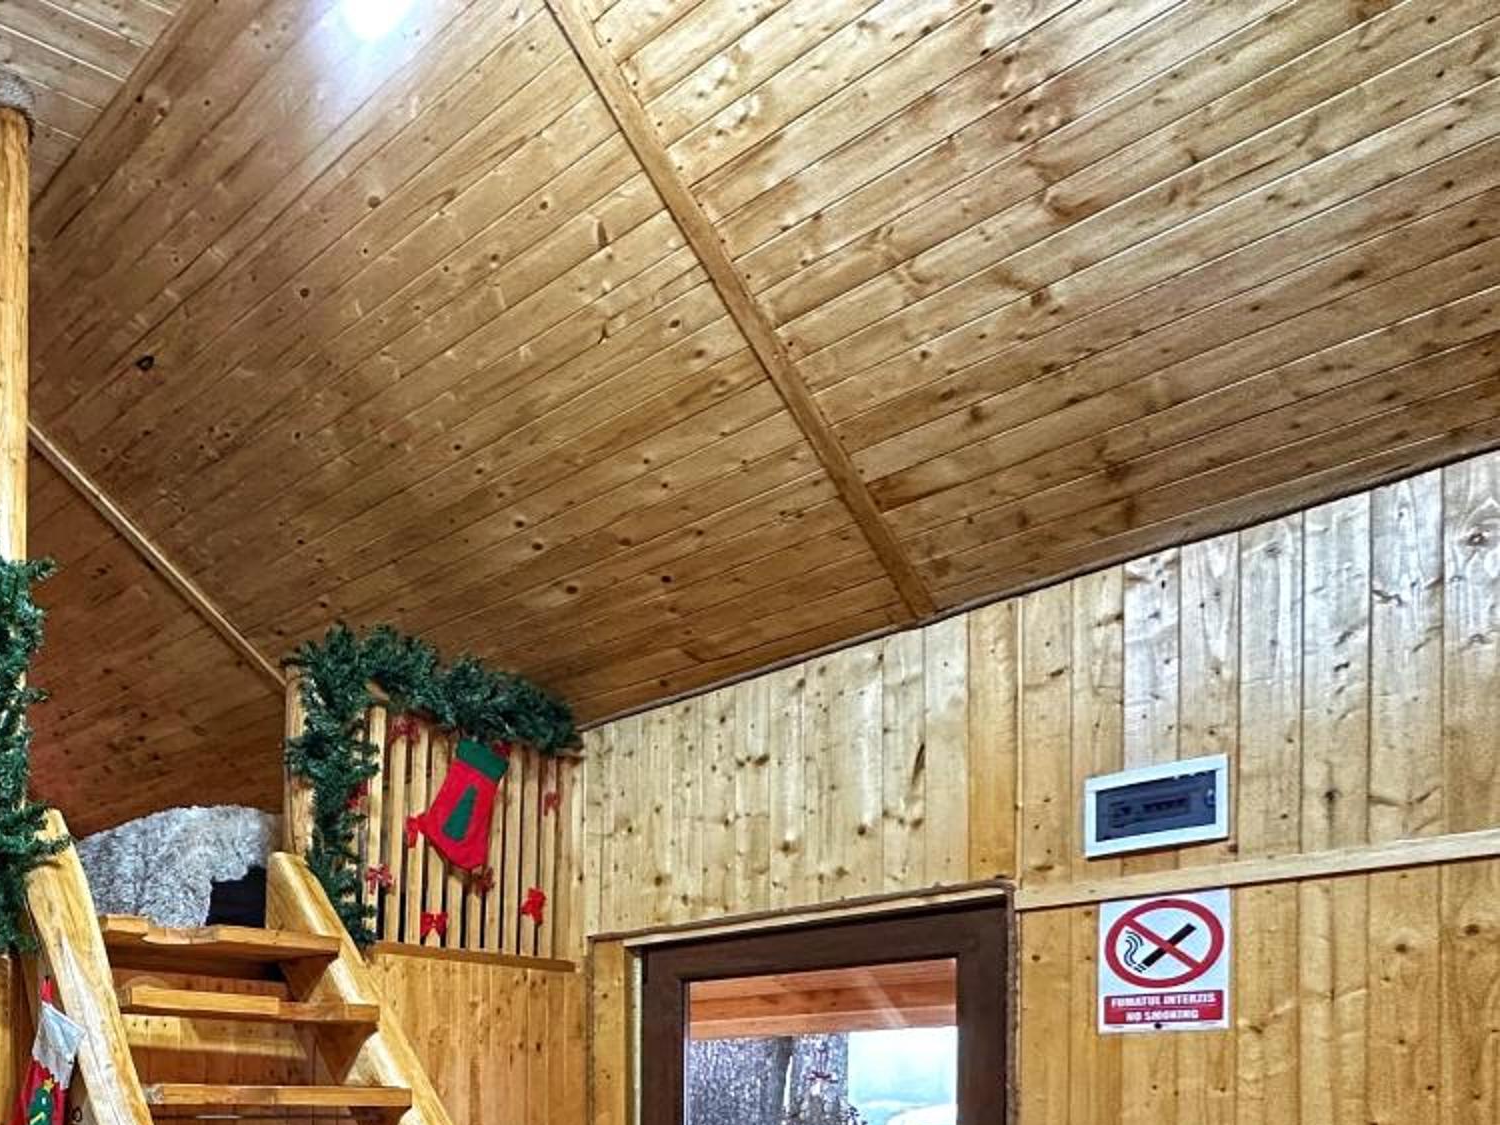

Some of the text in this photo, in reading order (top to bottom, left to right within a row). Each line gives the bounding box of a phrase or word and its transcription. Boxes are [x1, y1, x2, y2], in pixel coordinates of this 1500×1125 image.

[1111, 993, 1217, 1008] FUMATUL INTERZIS
[1125, 1009, 1199, 1022] NO SMOKING
